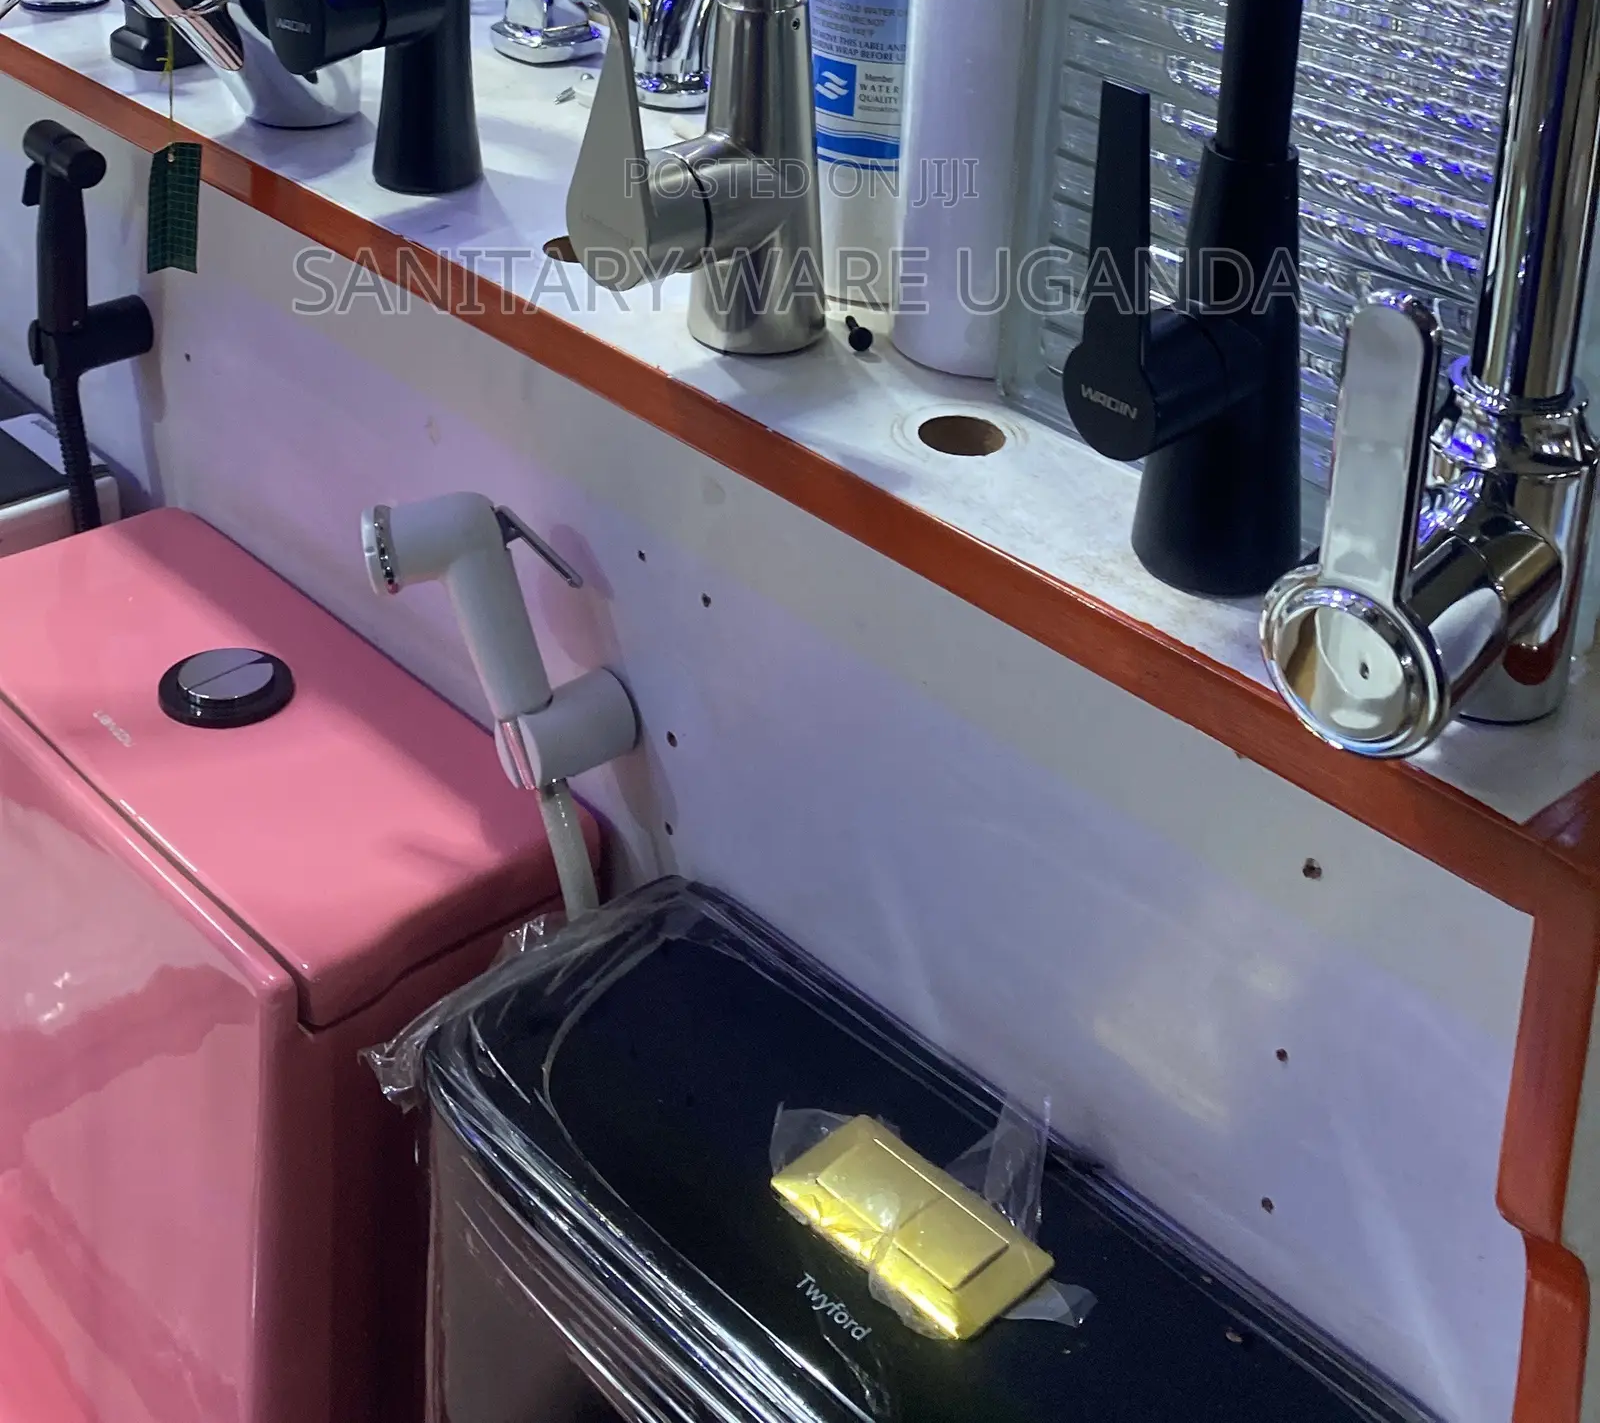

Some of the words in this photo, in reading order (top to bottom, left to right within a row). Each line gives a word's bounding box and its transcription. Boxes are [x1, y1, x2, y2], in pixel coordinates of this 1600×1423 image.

[859, 39, 884, 50] LABEL
[836, 45, 859, 57] WRAP
[860, 50, 893, 62] BEFORE
[859, 83, 900, 94] WATER
[858, 93, 899, 105] QUALITY
[796, 1270, 873, 1341] Twyford
